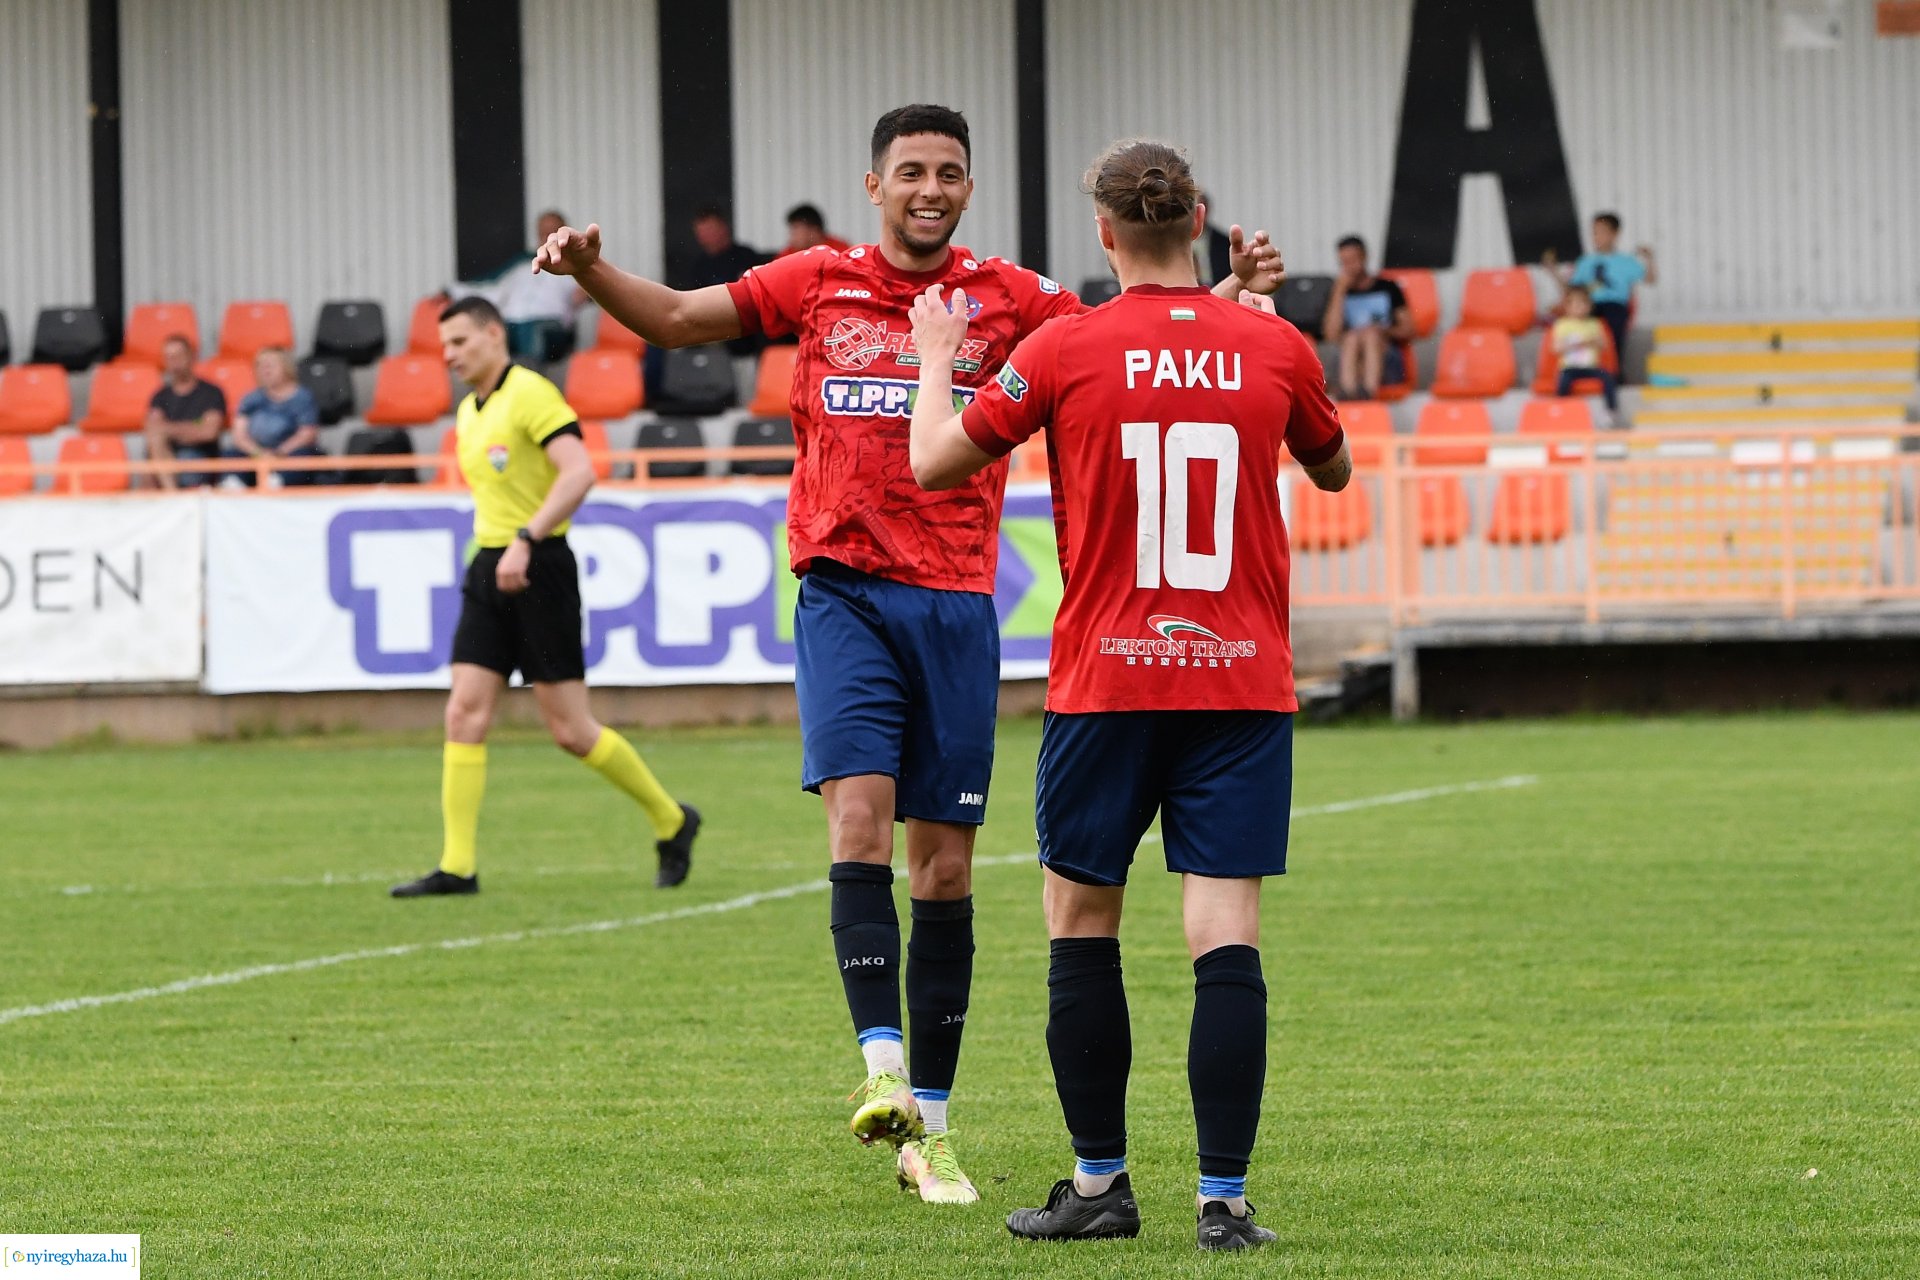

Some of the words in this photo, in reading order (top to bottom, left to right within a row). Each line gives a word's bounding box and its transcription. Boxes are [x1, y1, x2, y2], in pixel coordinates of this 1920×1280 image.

[835, 288, 872, 299] JAKO
[883, 332, 989, 362] RESZ
[899, 356, 922, 364] ALWAY
[1124, 349, 1241, 390] PAKU
[1120, 421, 1240, 592] 10
[1100, 637, 1187, 657] LERTON
[1190, 640, 1256, 658] TRANS
[1126, 656, 1232, 668] HUNGARY
[958, 792, 984, 806] JAKO
[843, 956, 885, 970] JAKO
[941, 1014, 967, 1025] JA
